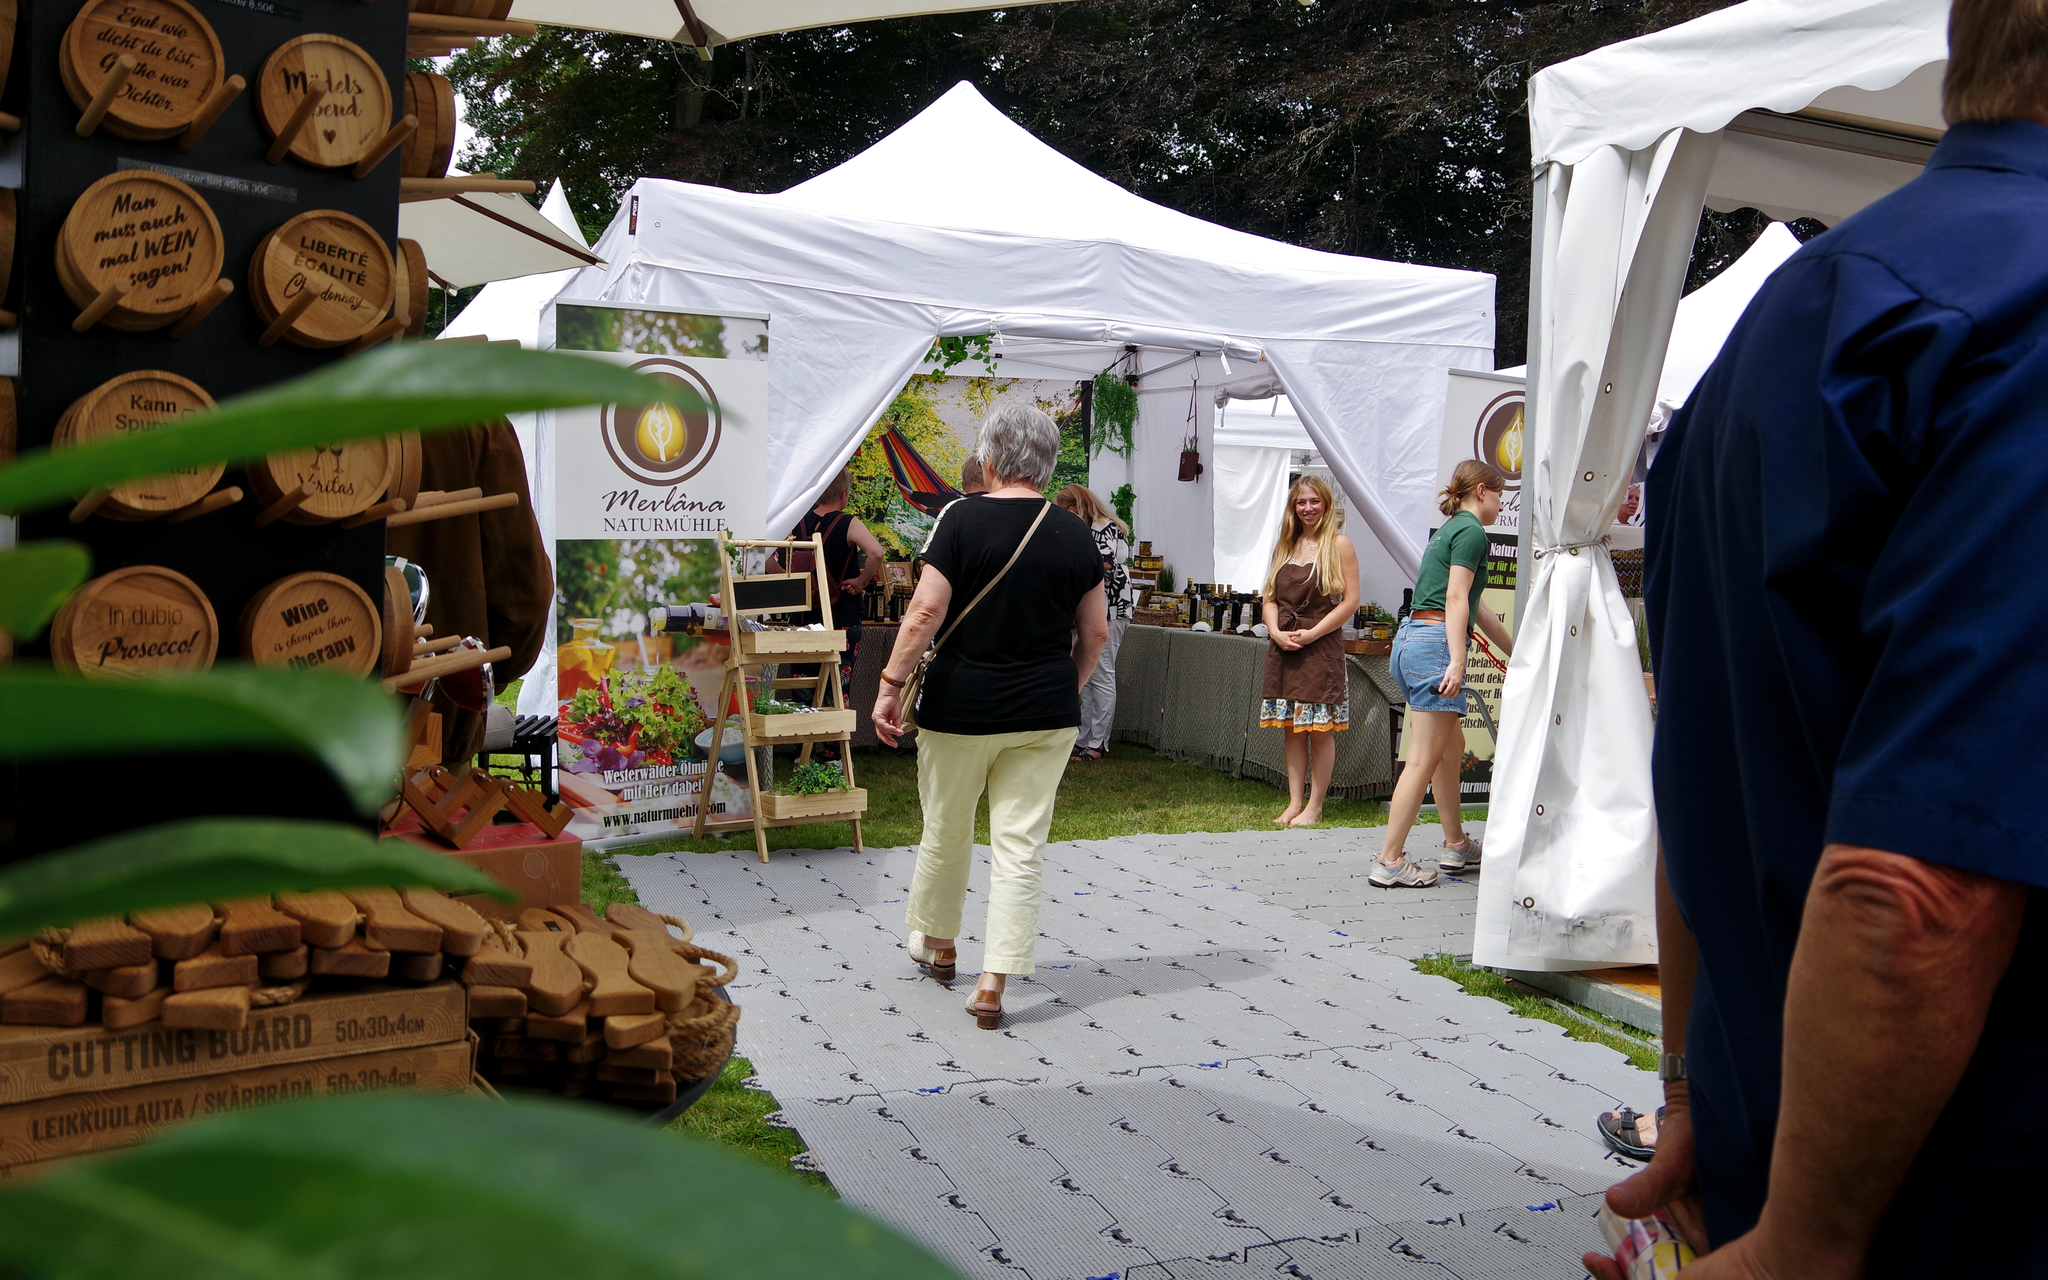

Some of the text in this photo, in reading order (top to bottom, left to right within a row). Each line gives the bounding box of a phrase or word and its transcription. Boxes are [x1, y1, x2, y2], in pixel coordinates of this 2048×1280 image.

[116, 6, 189, 38] Egal wie
[97, 28, 200, 68] dicht du bist,
[99, 52, 191, 89] Gthe war
[312, 95, 363, 118] bend
[251, 183, 268, 195] 30€
[111, 193, 158, 218] Man
[94, 205, 187, 243] muss auch
[100, 227, 199, 269] mal WEIN
[300, 236, 369, 267] LIBERTÉ
[130, 253, 192, 289] sagen!
[293, 251, 367, 286] ÉGALITÉ
[283, 272, 371, 311] Cdonnay
[130, 394, 177, 413] Kann
[115, 414, 172, 435] Spure
[297, 472, 355, 495] Vritas
[601, 486, 726, 512] Mevlâna
[603, 515, 726, 532] NATURMÜHLE
[1487, 560, 1517, 572] ur für fe
[1506, 577, 1516, 586] un
[109, 605, 183, 626] In dubio
[281, 598, 329, 628] Wine
[274, 616, 353, 652] is cheaper than
[98, 629, 201, 667] Prosecco!
[287, 635, 356, 672] therapy
[1466, 673, 1506, 684] nend deka
[1466, 702, 1494, 714] Zusze
[603, 760, 724, 784] Westerwälder Ölmüe
[623, 785, 642, 801] mit
[645, 783, 669, 798] Herz
[603, 802, 726, 828] www.naturmuehlom
[48, 1028, 197, 1082] CUTTING
[209, 1013, 313, 1060] BOARD
[33, 1098, 186, 1142] LEIKKUULAUTA
[204, 1078, 315, 1115] SKÄRBRÄDA
